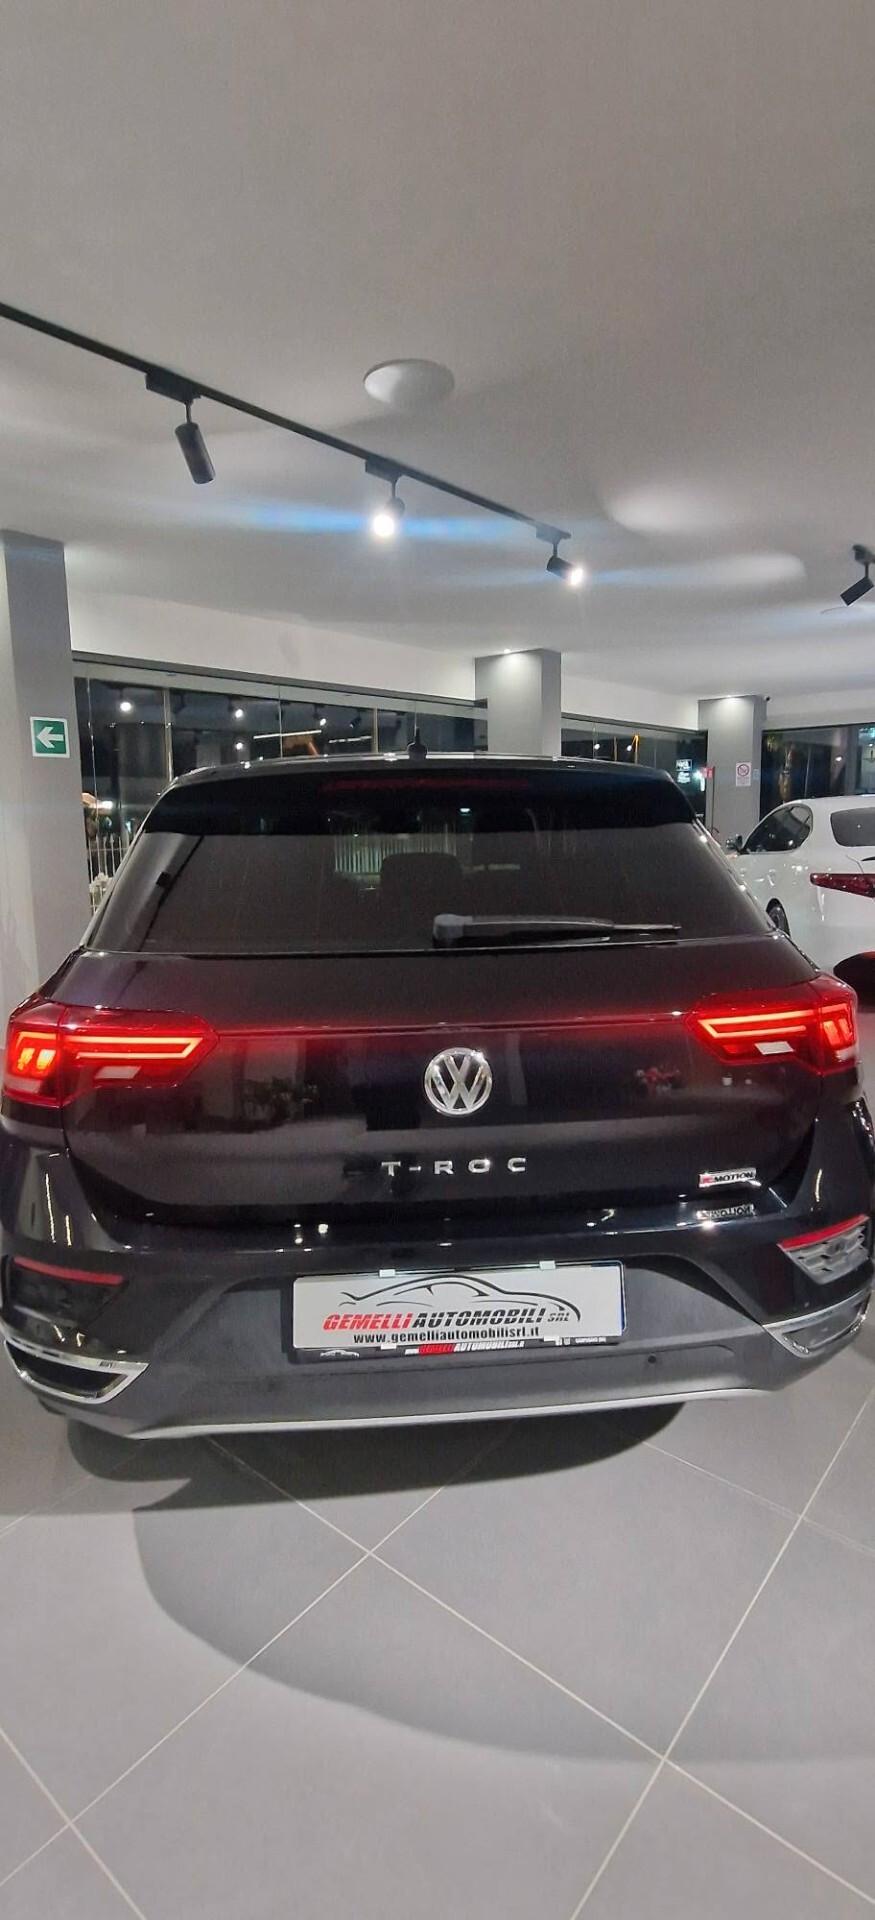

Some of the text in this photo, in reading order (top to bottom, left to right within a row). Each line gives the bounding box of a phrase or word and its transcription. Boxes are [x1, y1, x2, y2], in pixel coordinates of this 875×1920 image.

[381, 1157, 526, 1177] T-ROC
[323, 1313, 413, 1331] GEMELLI
[412, 1308, 546, 1329] AUTOMOBILI
[353, 1326, 540, 1344] www.gemelliautomobilisrl.it
